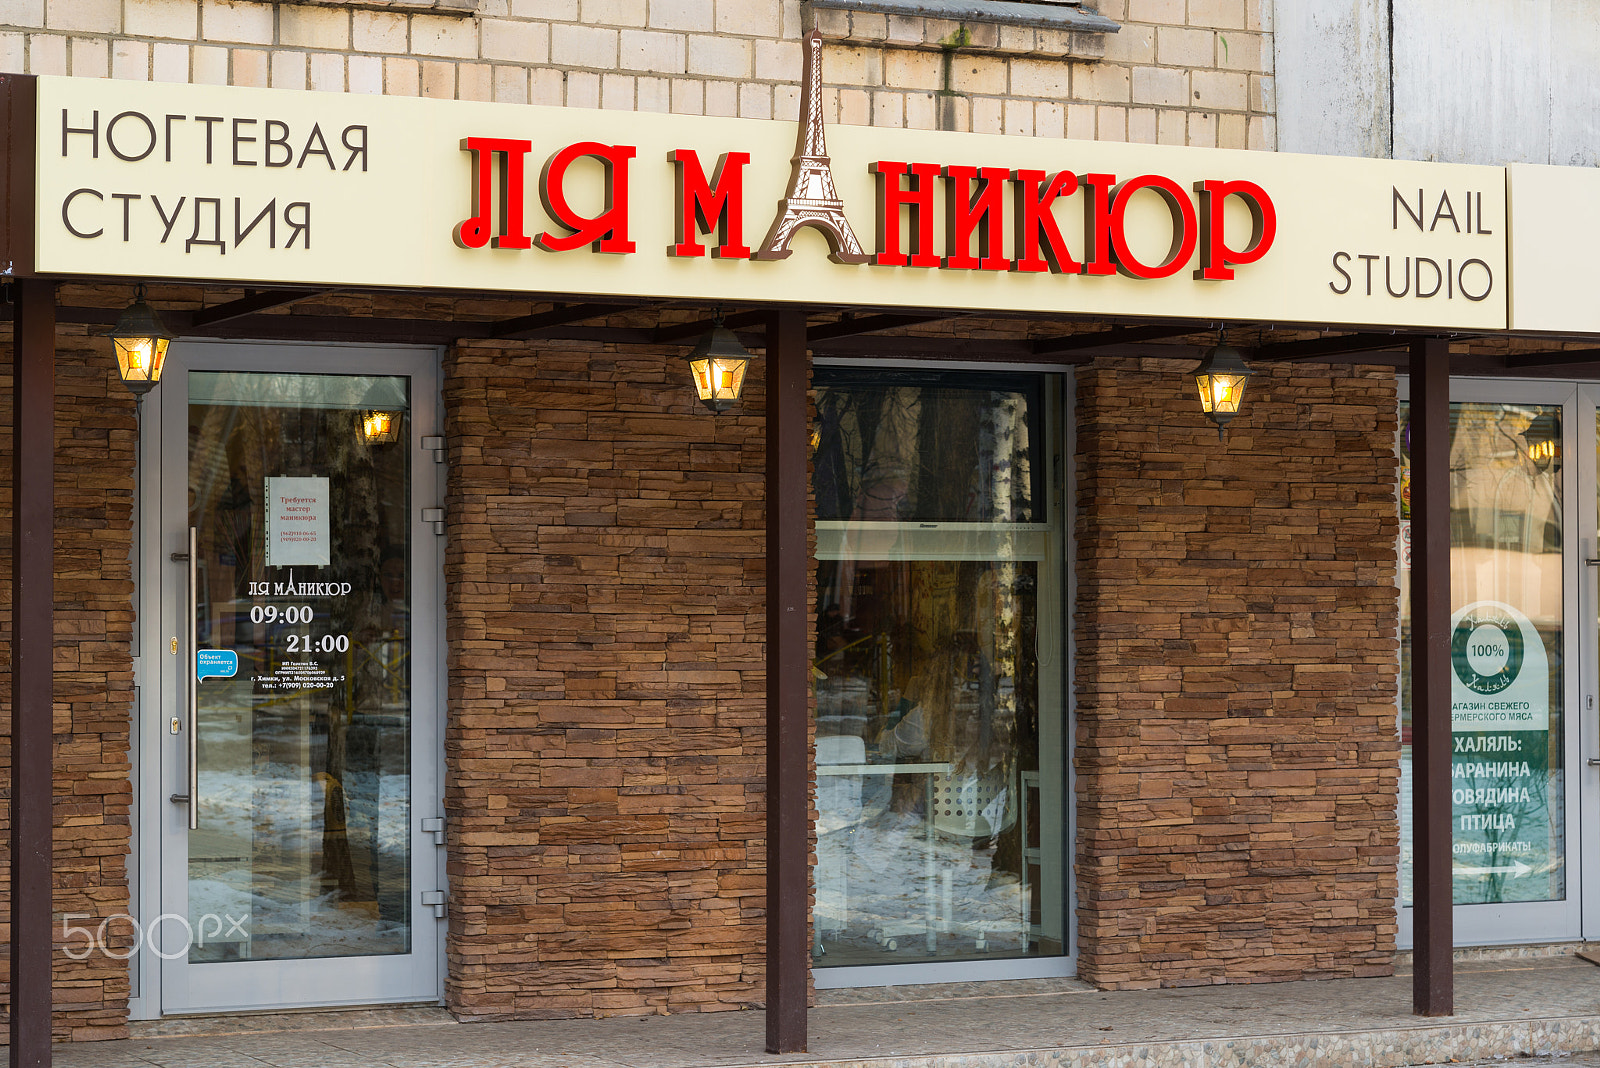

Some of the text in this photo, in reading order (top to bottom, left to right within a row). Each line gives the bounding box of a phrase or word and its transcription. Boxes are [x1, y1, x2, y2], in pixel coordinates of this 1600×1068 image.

[61, 108, 368, 172] НОГТЕВАЯ
[453, 30, 1277, 281] ЛЯ МАНИКЮР
[1392, 185, 1493, 235] NAIL
[61, 187, 311, 255] СТУДИЯ
[1328, 251, 1493, 302] STUDIO
[280, 496, 317, 504] Требуется
[248, 568, 352, 596] ЛЯ МАНИКЮР
[250, 605, 314, 624] 09:00
[286, 634, 350, 653] 21:00
[1471, 644, 1505, 657] 100%
[257, 675, 281, 683] Химки,
[278, 682, 302, 690] +7(909)
[1451, 702, 1530, 711] АГАЗИН СВЕЖЕГО
[1509, 712, 1533, 721] МЯСА
[1454, 736, 1522, 752] ХАЛЯЛЬ:
[1451, 787, 1531, 808] ОВЯДИНА
[1460, 813, 1516, 833] ПТИЦА
[1452, 841, 1531, 855] ОЛУФАБРИКАТЫ
